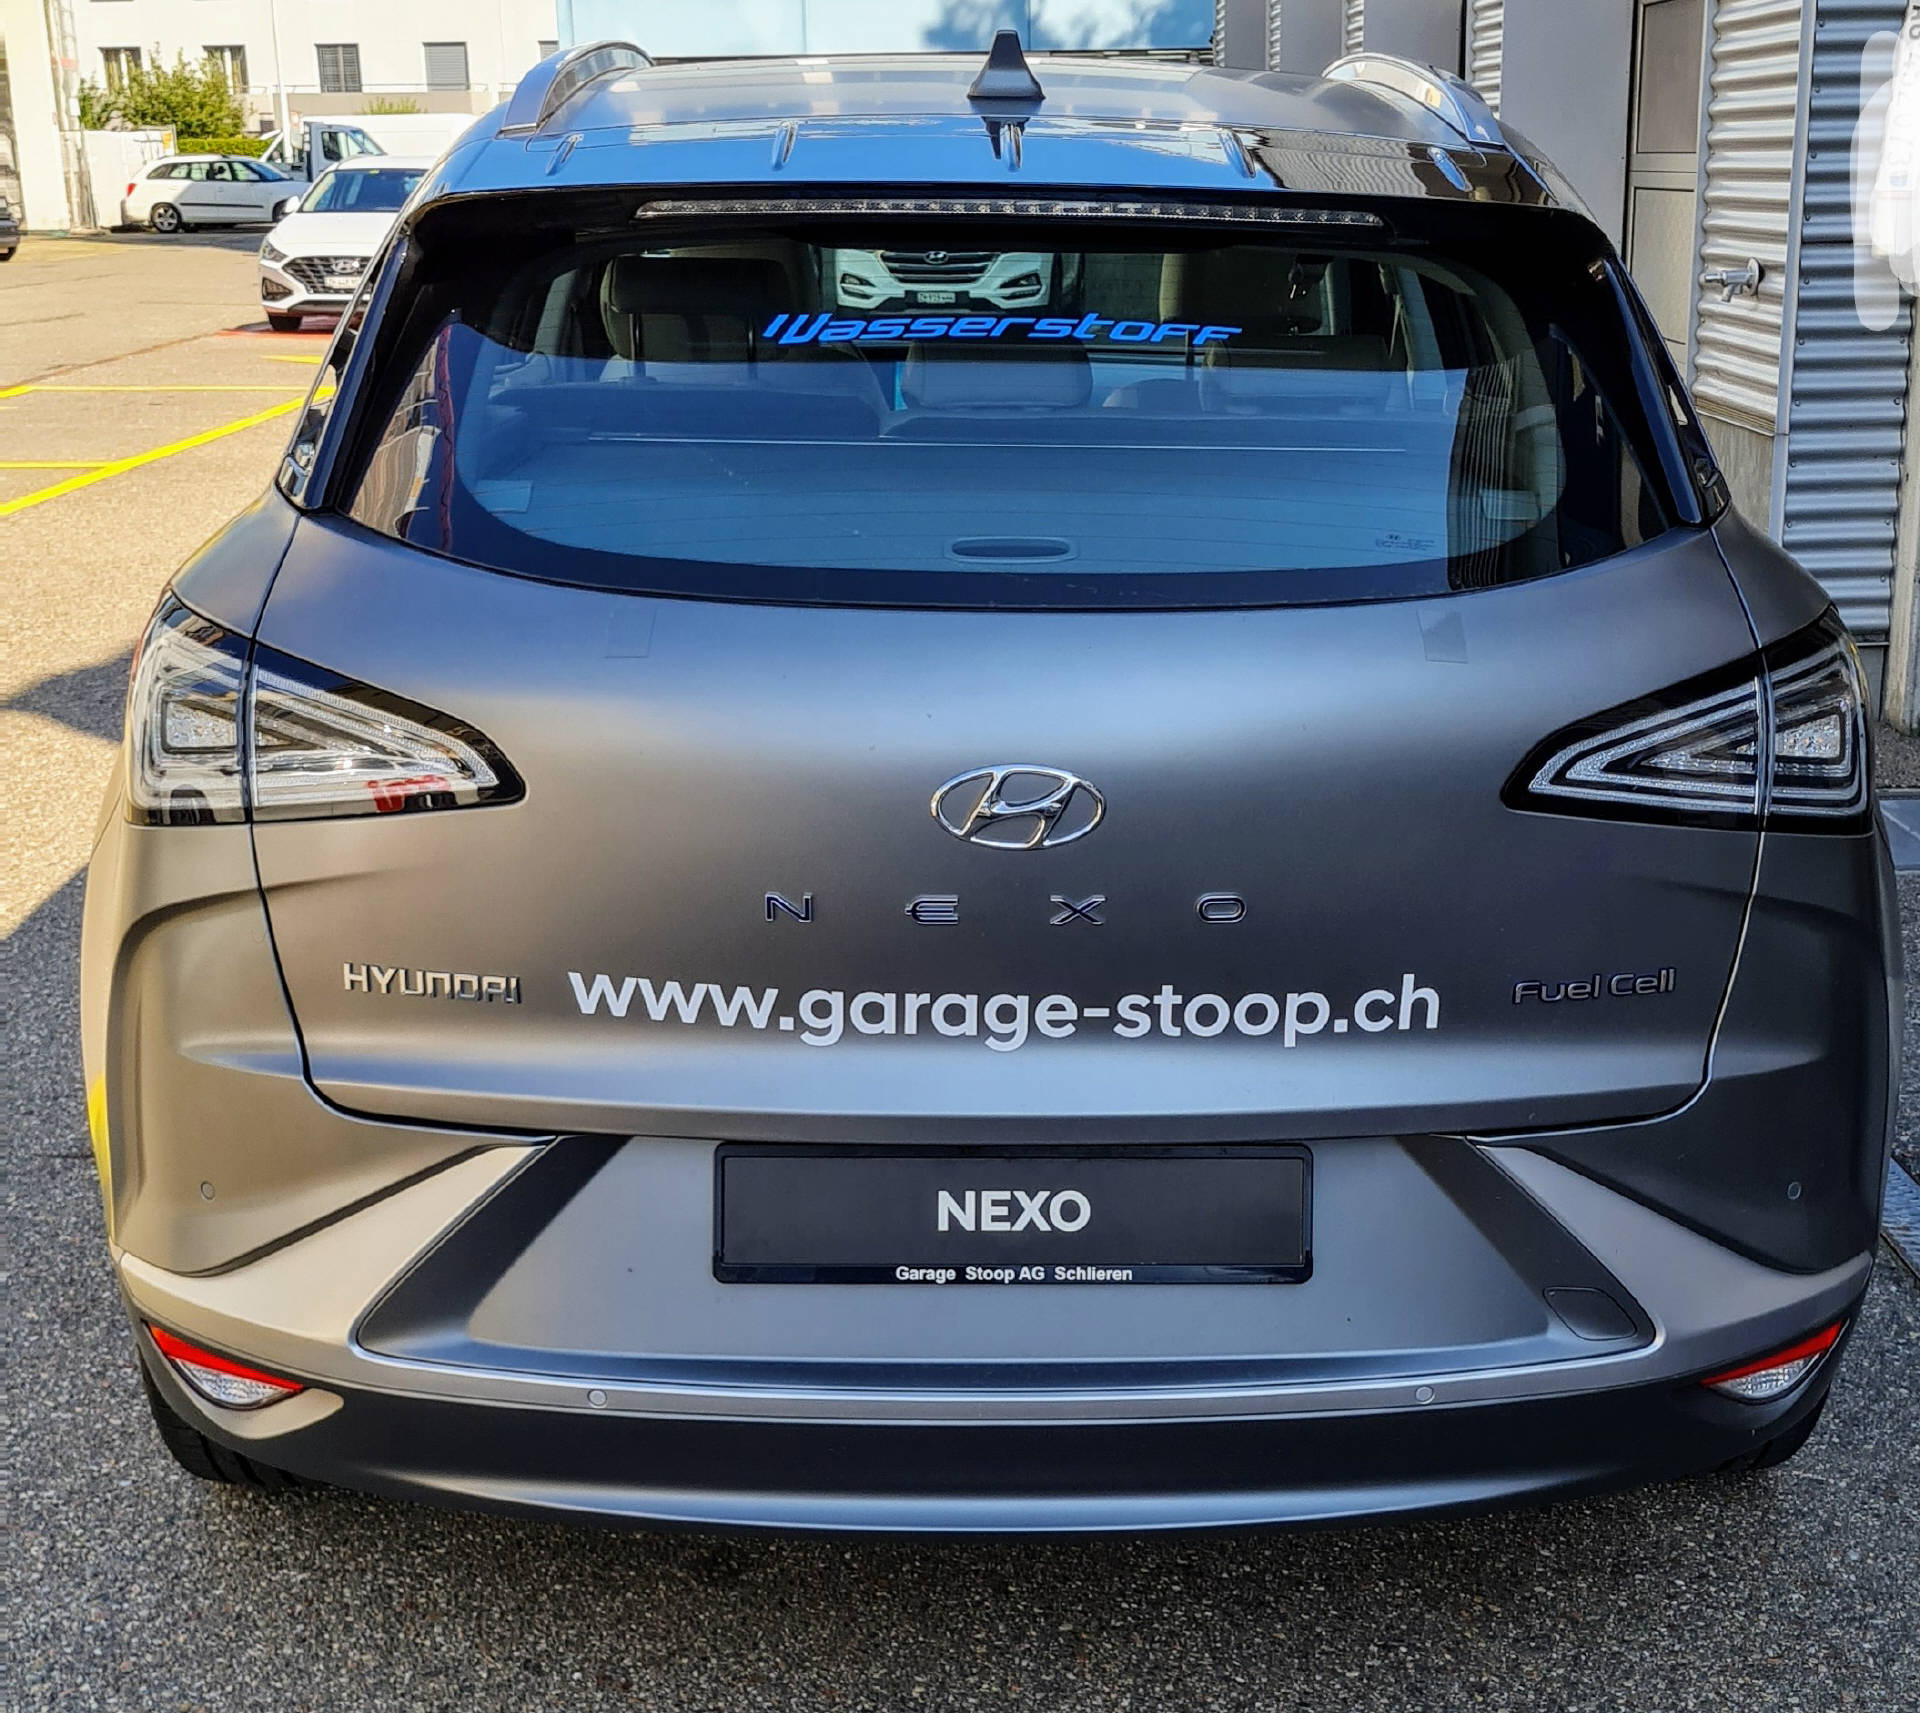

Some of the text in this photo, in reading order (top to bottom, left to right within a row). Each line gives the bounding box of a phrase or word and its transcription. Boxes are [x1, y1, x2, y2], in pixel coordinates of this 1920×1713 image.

[765, 892, 1247, 925] NEXO
[343, 962, 522, 1004] HYUNDAI
[1513, 968, 1677, 1005] Fuel Cell
[568, 971, 1440, 1052] www.garage-stoop.ch
[937, 1189, 1092, 1232] NEXO
[895, 1266, 1134, 1284] Garage Stoop AG Schlieren
